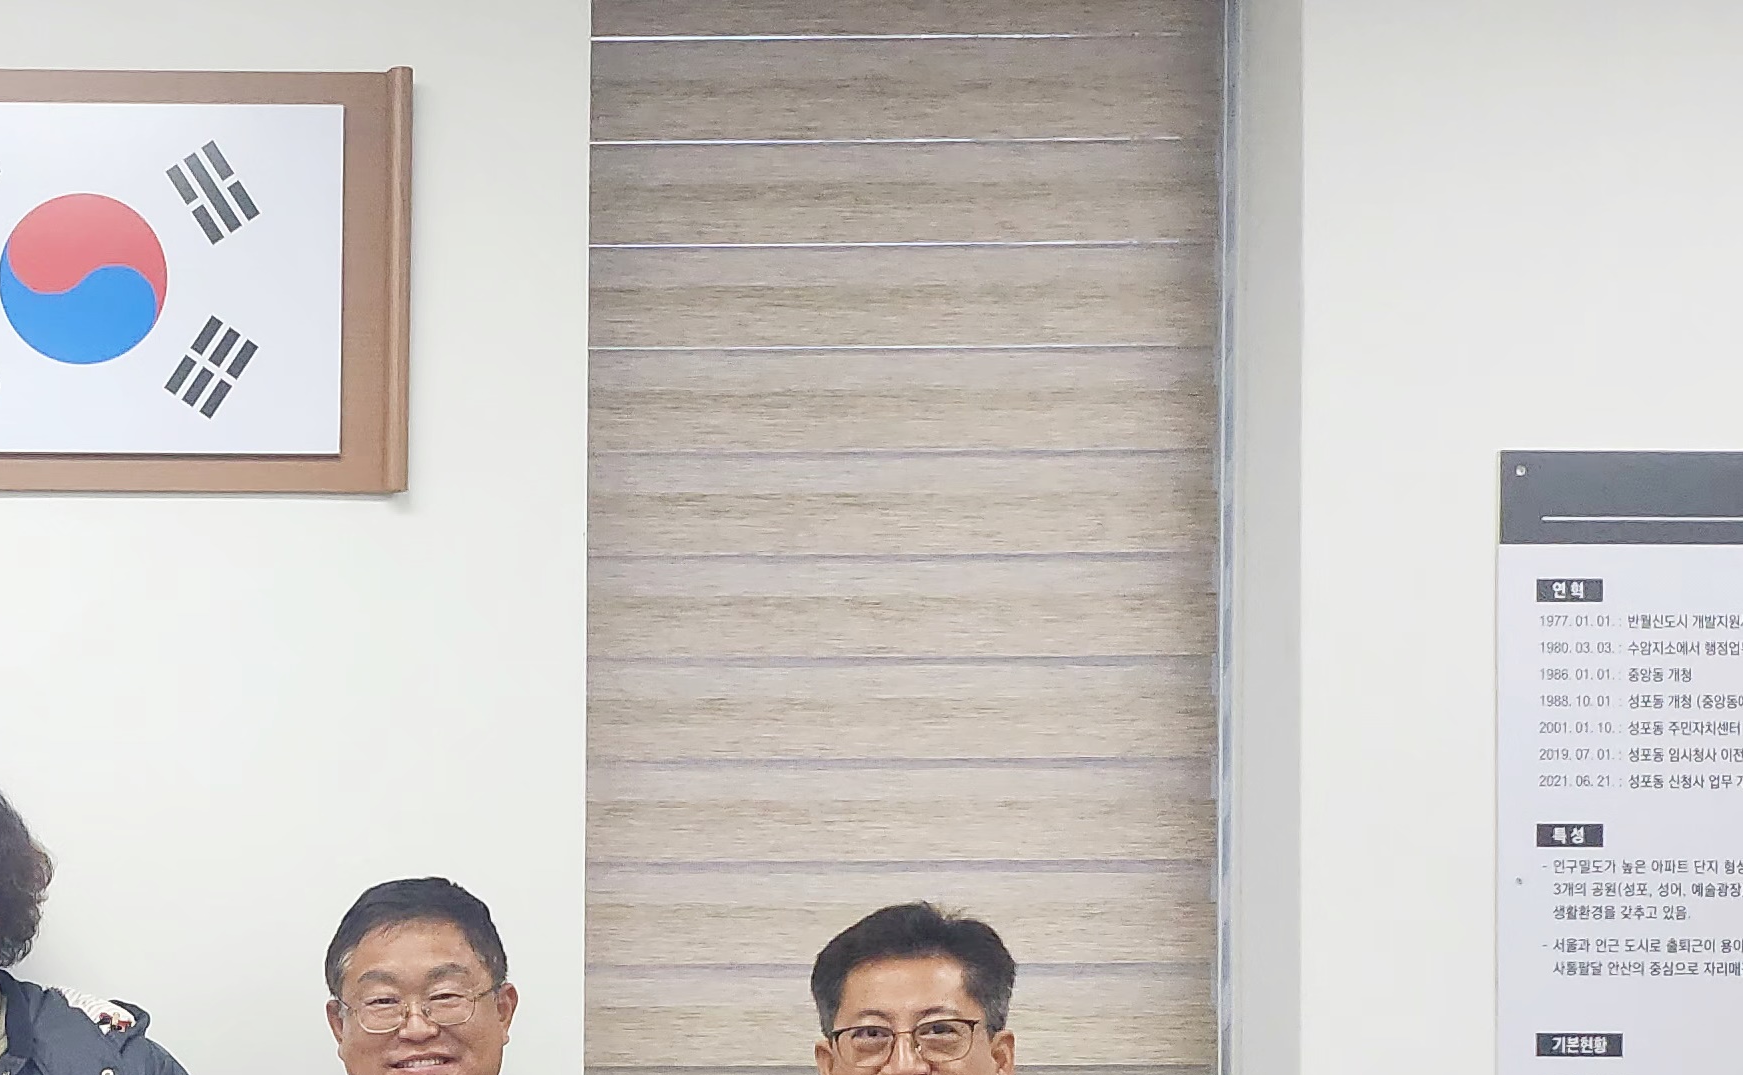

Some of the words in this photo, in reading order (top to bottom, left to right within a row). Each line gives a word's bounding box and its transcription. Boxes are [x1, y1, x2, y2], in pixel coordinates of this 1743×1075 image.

[1628, 614, 1687, 629] 반월신도시
[1693, 614, 1743, 629] 개발지원
[1628, 641, 1699, 656] 수암지소에서
[1629, 668, 1663, 682] 중앙동
[1668, 668, 1691, 682] 개청
[1628, 694, 1664, 709] 성포동
[1669, 695, 1691, 709] 개청
[1628, 721, 1663, 735] 성포동
[1668, 721, 1740, 736] 주민자치센터
[1629, 748, 1664, 762] 성포동
[1669, 748, 1717, 762] 임시청사
[1629, 775, 1663, 789] 성포동
[1669, 775, 1704, 789] 신청사
[1709, 775, 1732, 789] 업무
[1553, 827, 1583, 844] 특성
[1554, 860, 1616, 874] 인구밀도가
[1622, 860, 1645, 874] 높은
[1652, 860, 1688, 873] 아파트
[1694, 860, 1718, 874] 단지
[1554, 883, 1586, 896] 3개의
[1692, 883, 1743, 897] 예술광장
[1553, 905, 1615, 920] 생활환경을
[1621, 905, 1657, 920] 갖추고
[1553, 938, 1590, 953] 서울과
[1596, 939, 1619, 953] 인근
[1625, 938, 1661, 952] 도시로
[1667, 938, 1715, 953] 출퇴근이
[1553, 962, 1602, 976] 사통팔달
[1608, 962, 1644, 976] 안산의
[1649, 962, 1699, 976] 중심으로
[1704, 962, 1743, 976] 자리매
[1553, 1037, 1607, 1053] 기본현황
